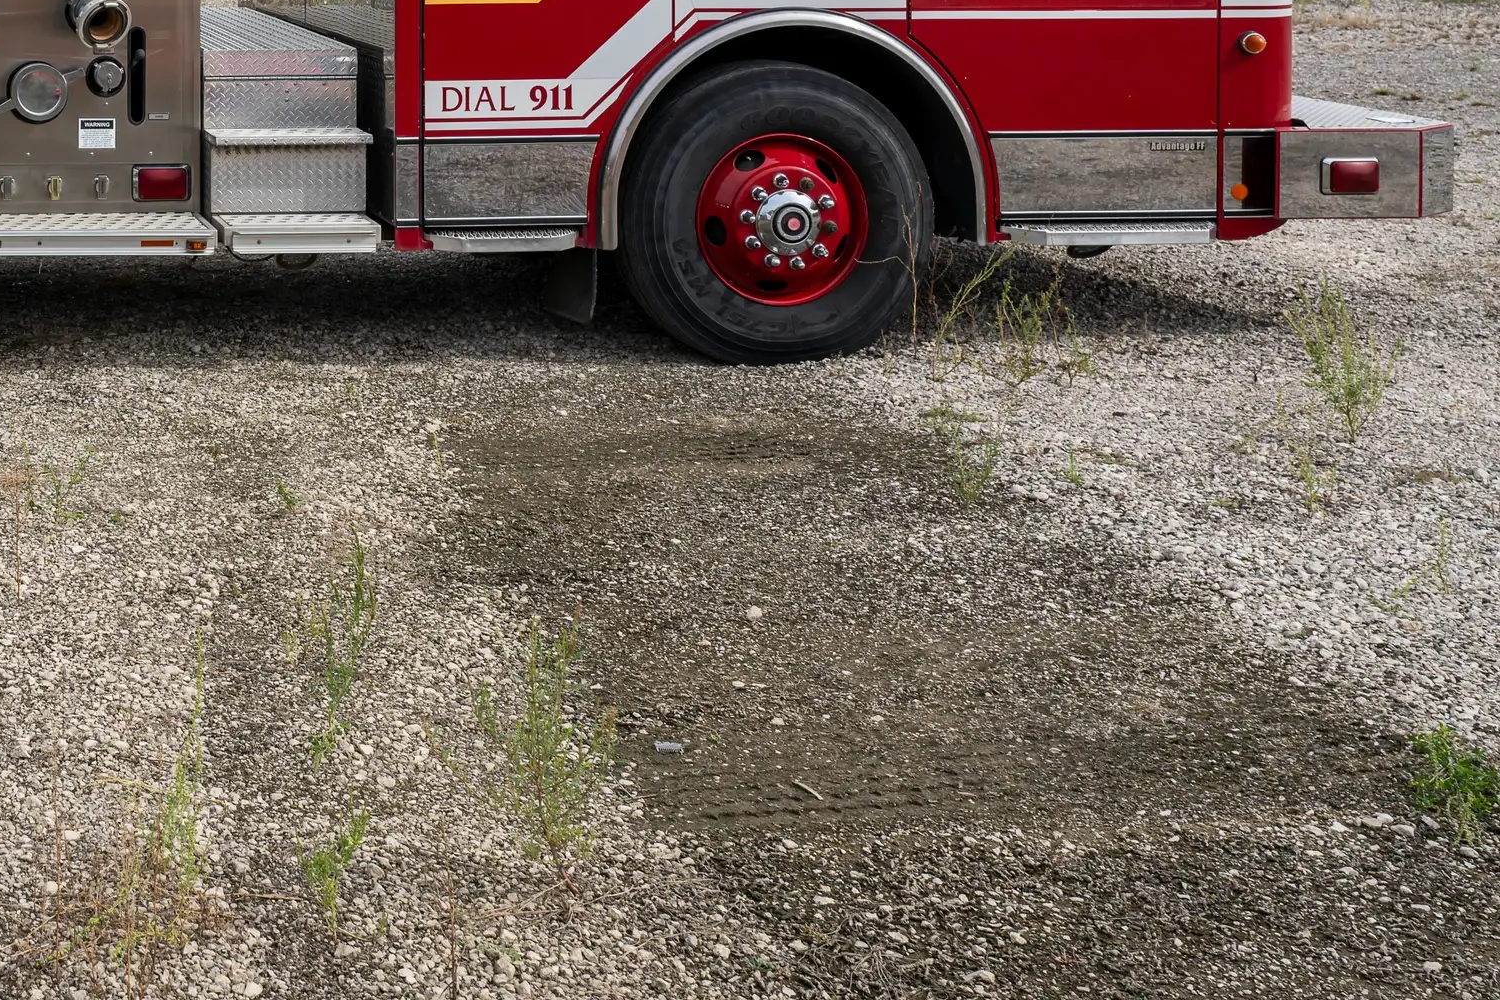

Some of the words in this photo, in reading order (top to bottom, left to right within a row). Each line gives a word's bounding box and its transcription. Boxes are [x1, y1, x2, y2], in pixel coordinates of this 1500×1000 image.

[441, 86, 516, 112] DIAL
[529, 84, 574, 111] 911
[1150, 141, 1195, 151] Advantage
[1196, 141, 1205, 150] FF
